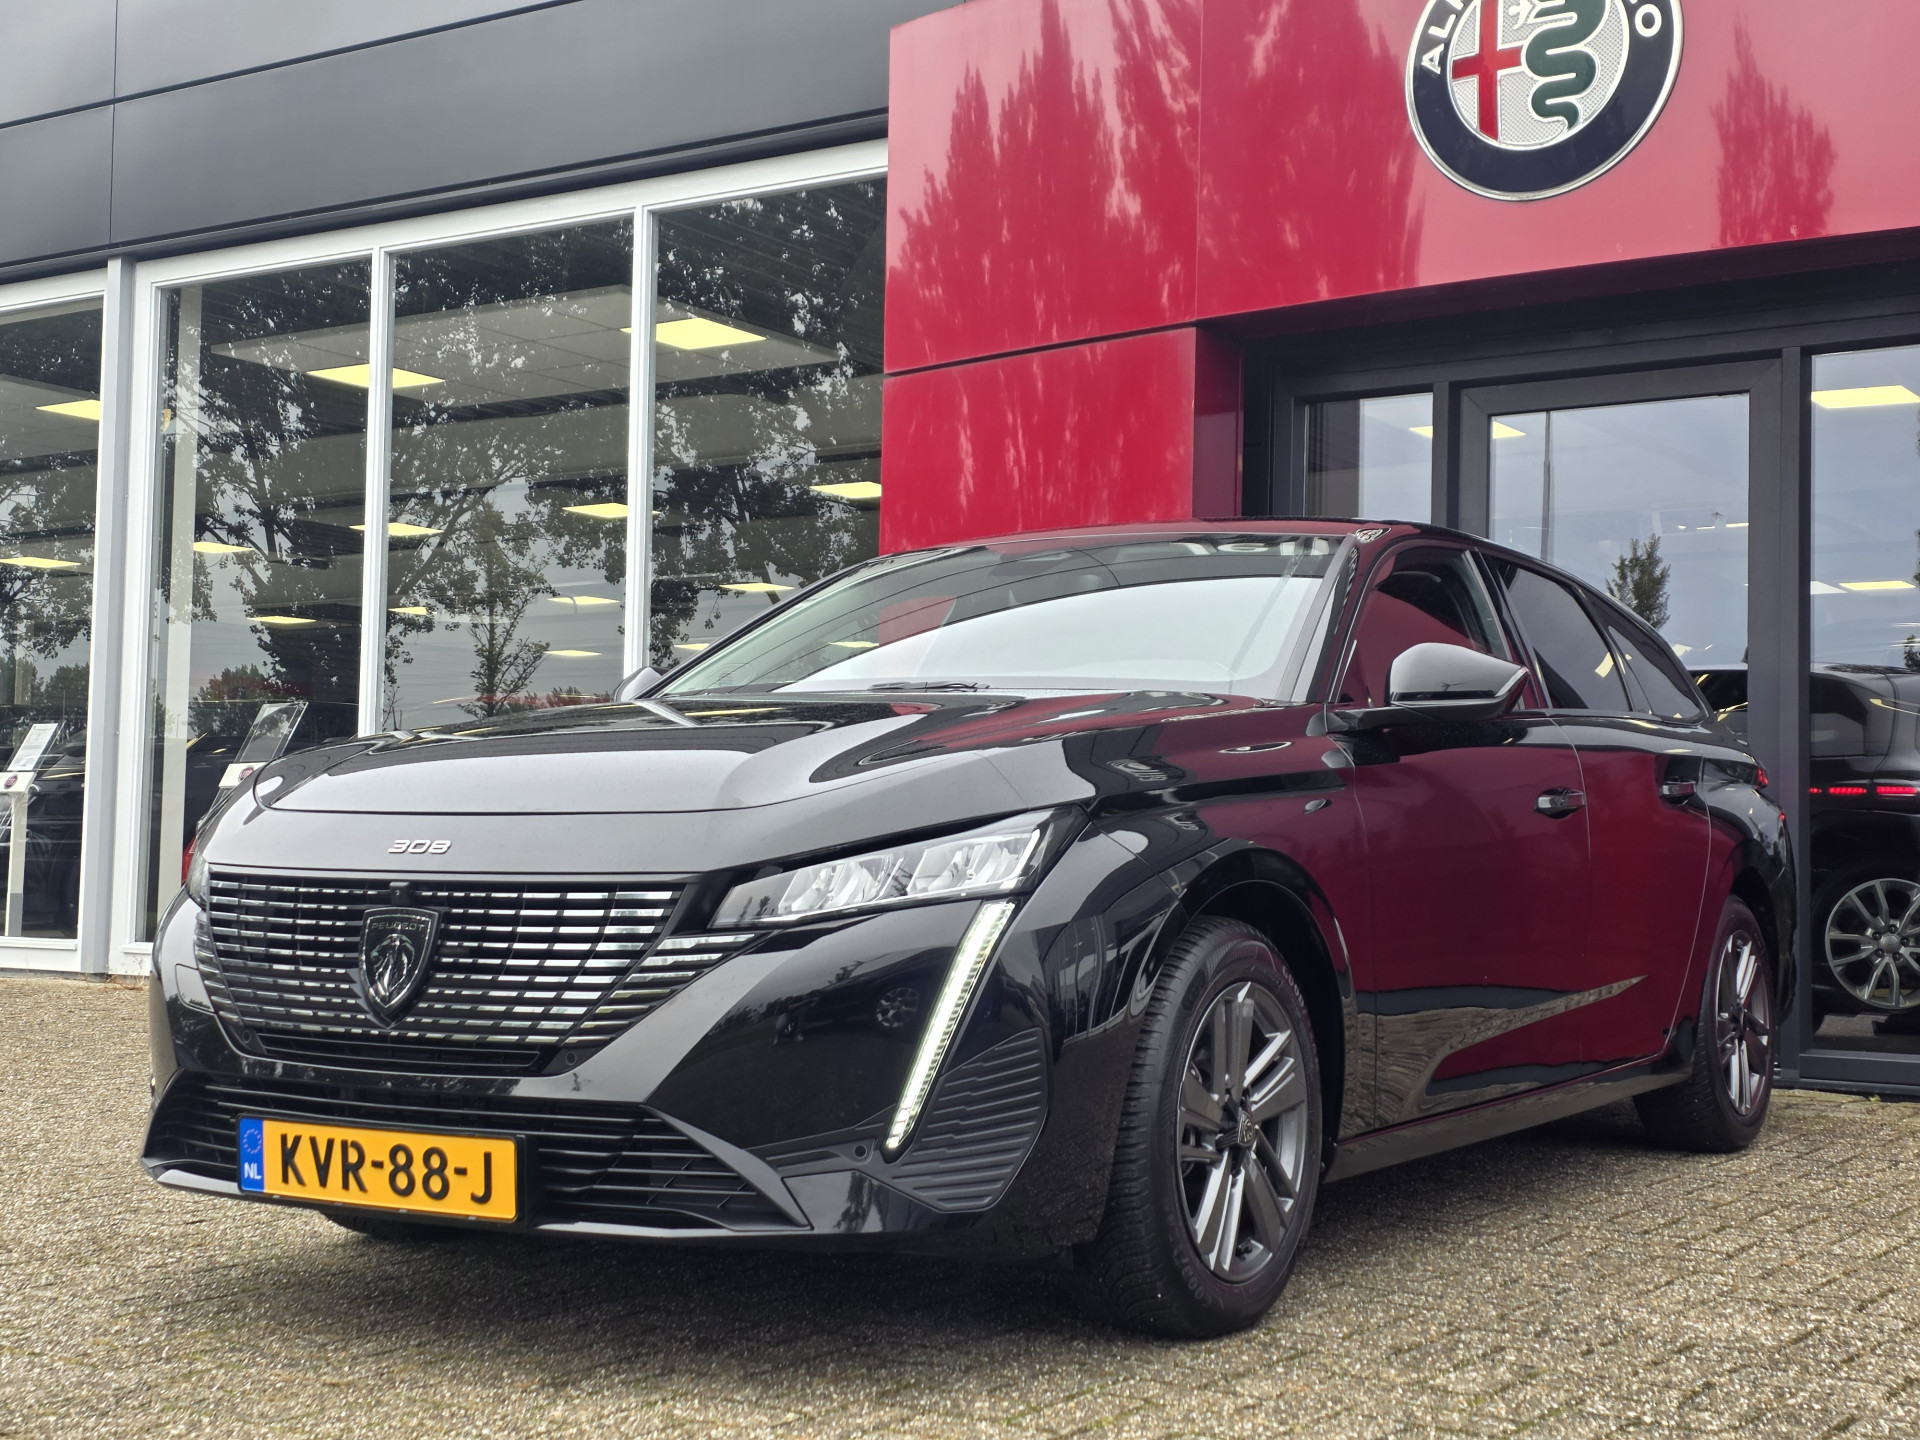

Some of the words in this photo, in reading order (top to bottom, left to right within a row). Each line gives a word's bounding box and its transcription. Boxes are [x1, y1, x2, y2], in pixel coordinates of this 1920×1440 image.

[388, 840, 452, 854] 308
[371, 921, 425, 931] PEUGEOT
[244, 1162, 261, 1180] NL
[280, 1133, 492, 1204] KVR-88-J
